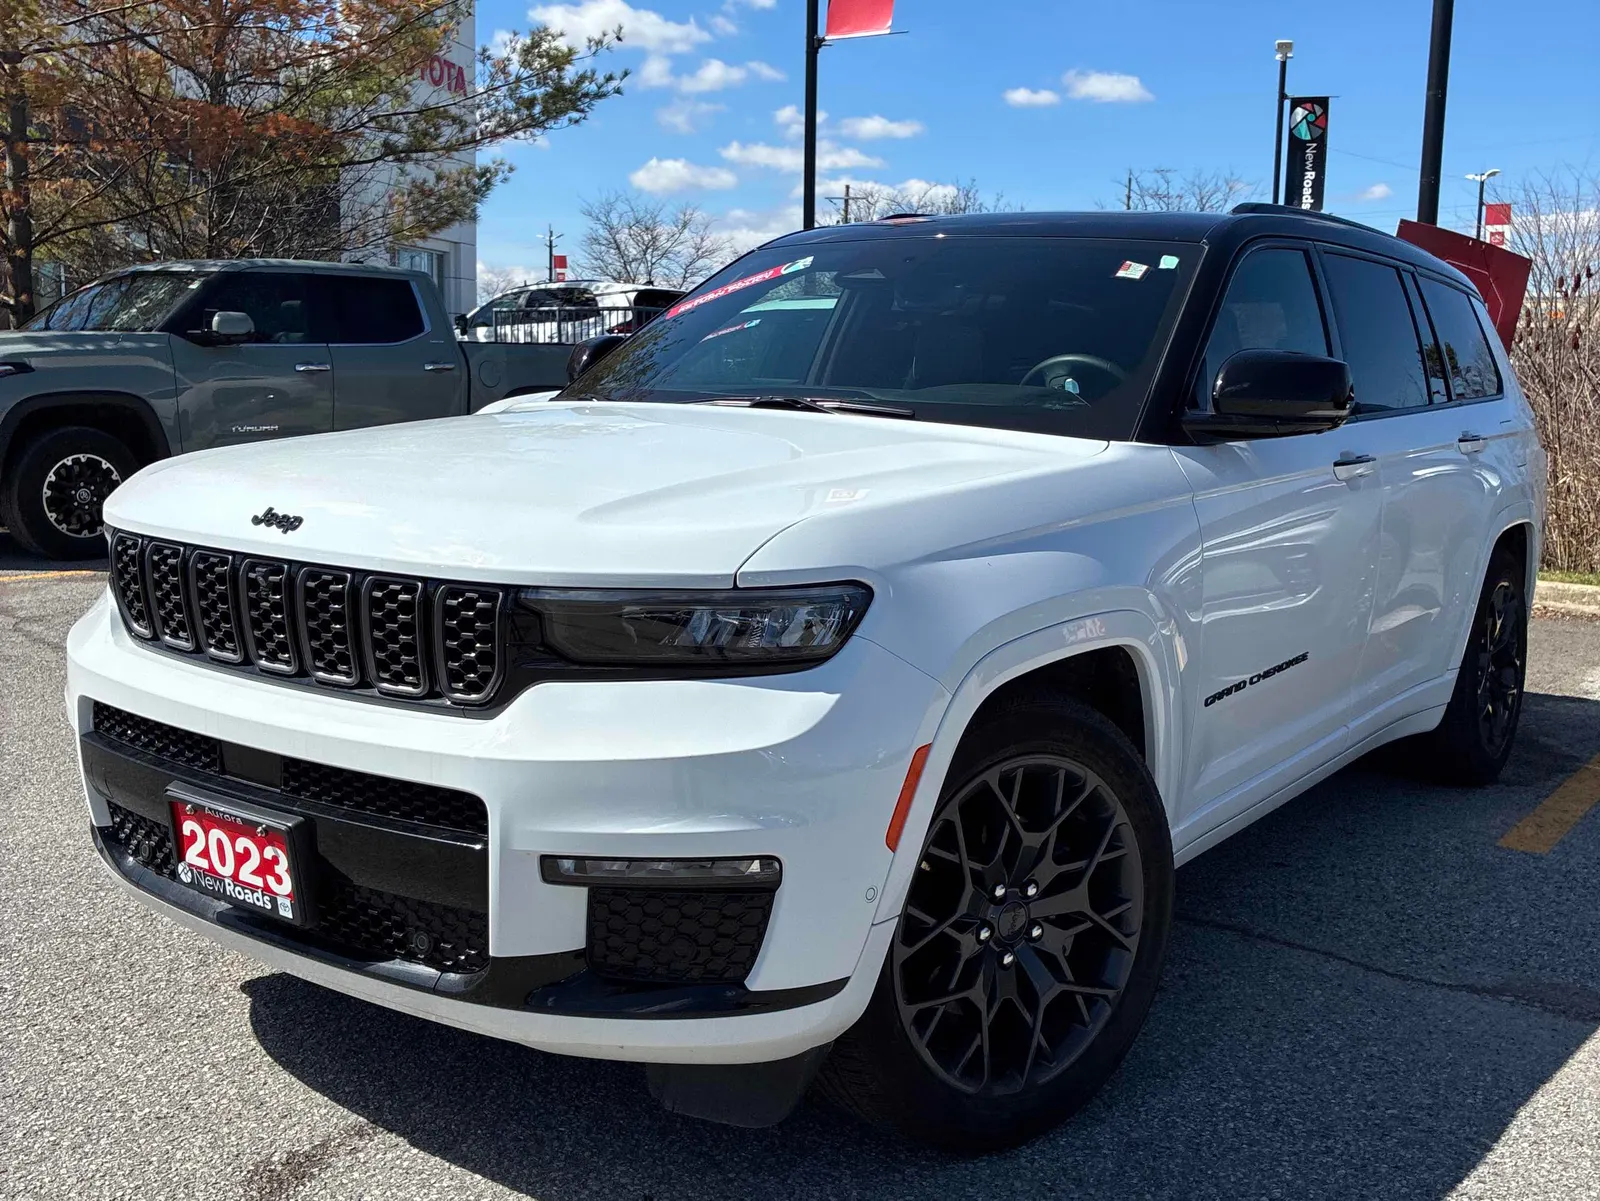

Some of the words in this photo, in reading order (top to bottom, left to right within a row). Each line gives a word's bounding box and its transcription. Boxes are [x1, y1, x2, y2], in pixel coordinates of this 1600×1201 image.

[405, 55, 468, 97] OTA
[1302, 143, 1318, 210] NewRoads
[251, 506, 304, 535] Jeep
[1204, 680, 1247, 707] GRAND
[1249, 651, 1309, 685] CHEROKEE
[205, 807, 243, 825] Aurora
[182, 820, 293, 896] 2023
[193, 868, 272, 909] NewRoads
